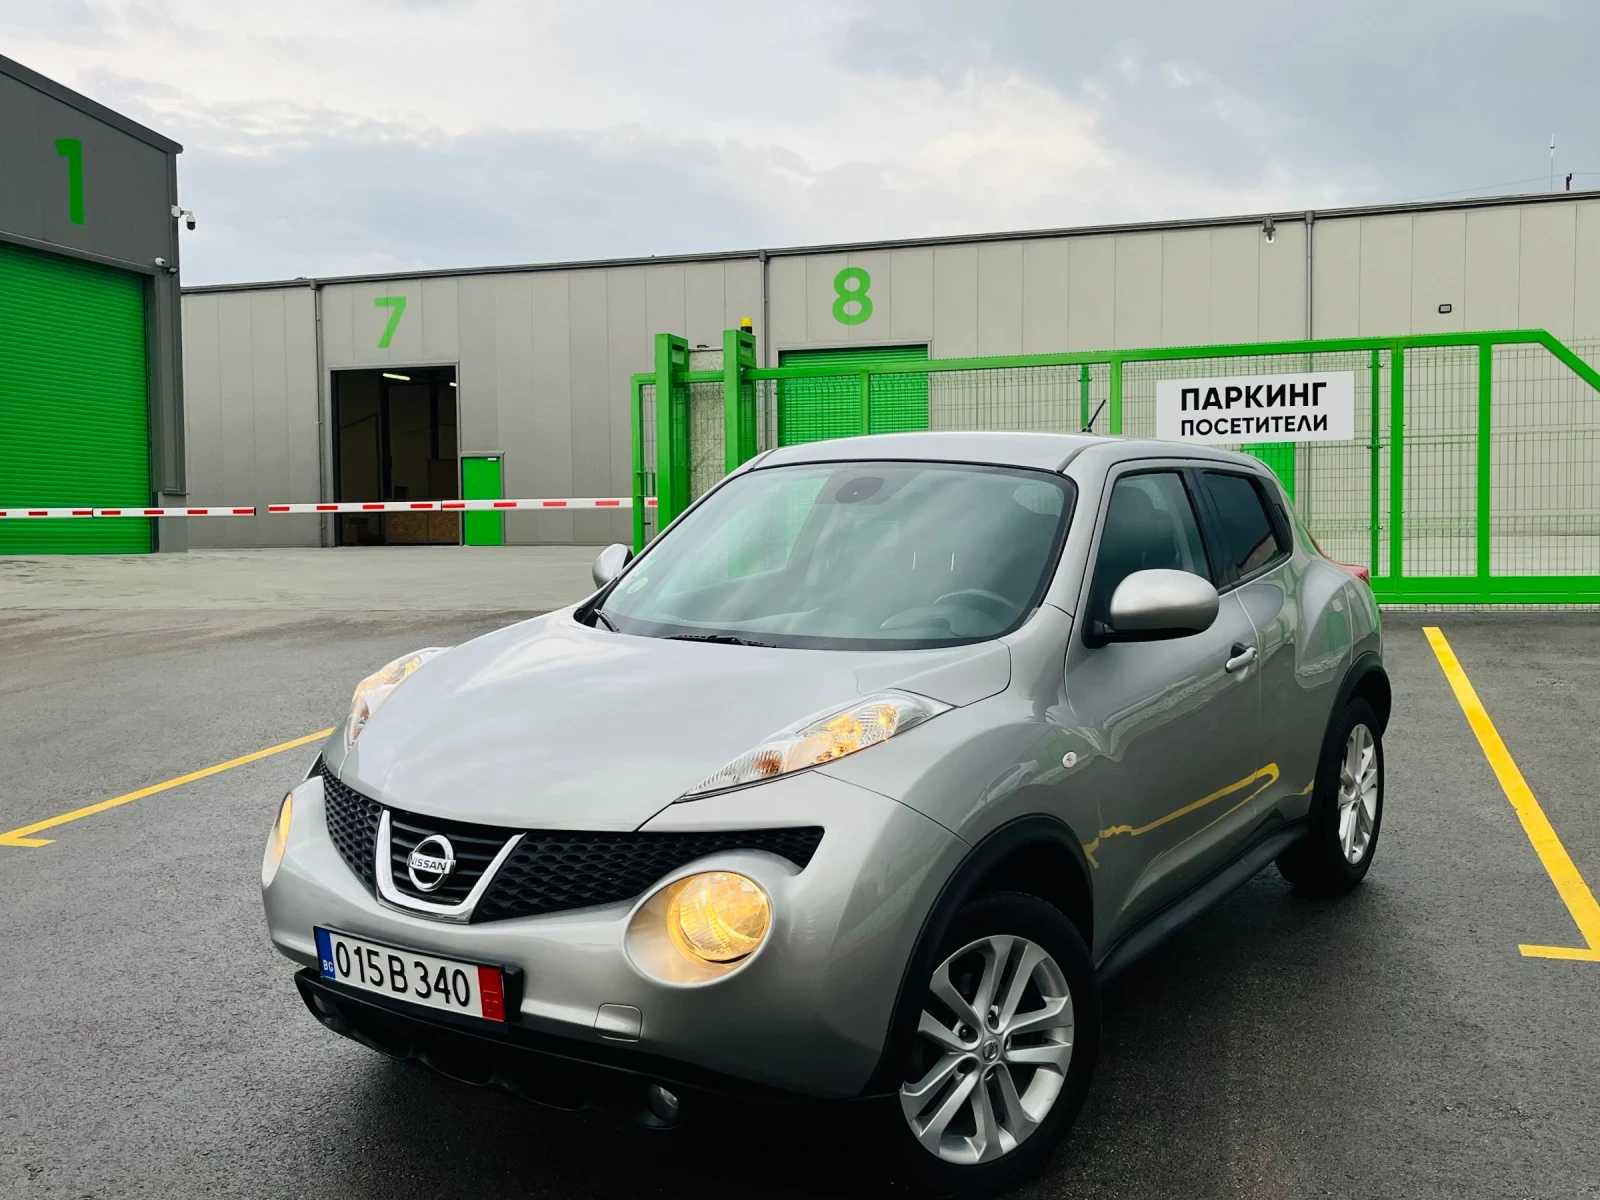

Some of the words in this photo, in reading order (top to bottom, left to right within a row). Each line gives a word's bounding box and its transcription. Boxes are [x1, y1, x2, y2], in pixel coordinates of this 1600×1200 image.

[54, 137, 85, 226] 1
[832, 267, 873, 325] 8
[374, 296, 407, 349] 7
[1181, 382, 1327, 411] ПАРКИНГ
[1181, 414, 1328, 436] ПОСЕТИТЕЛИ
[323, 959, 334, 973] BG
